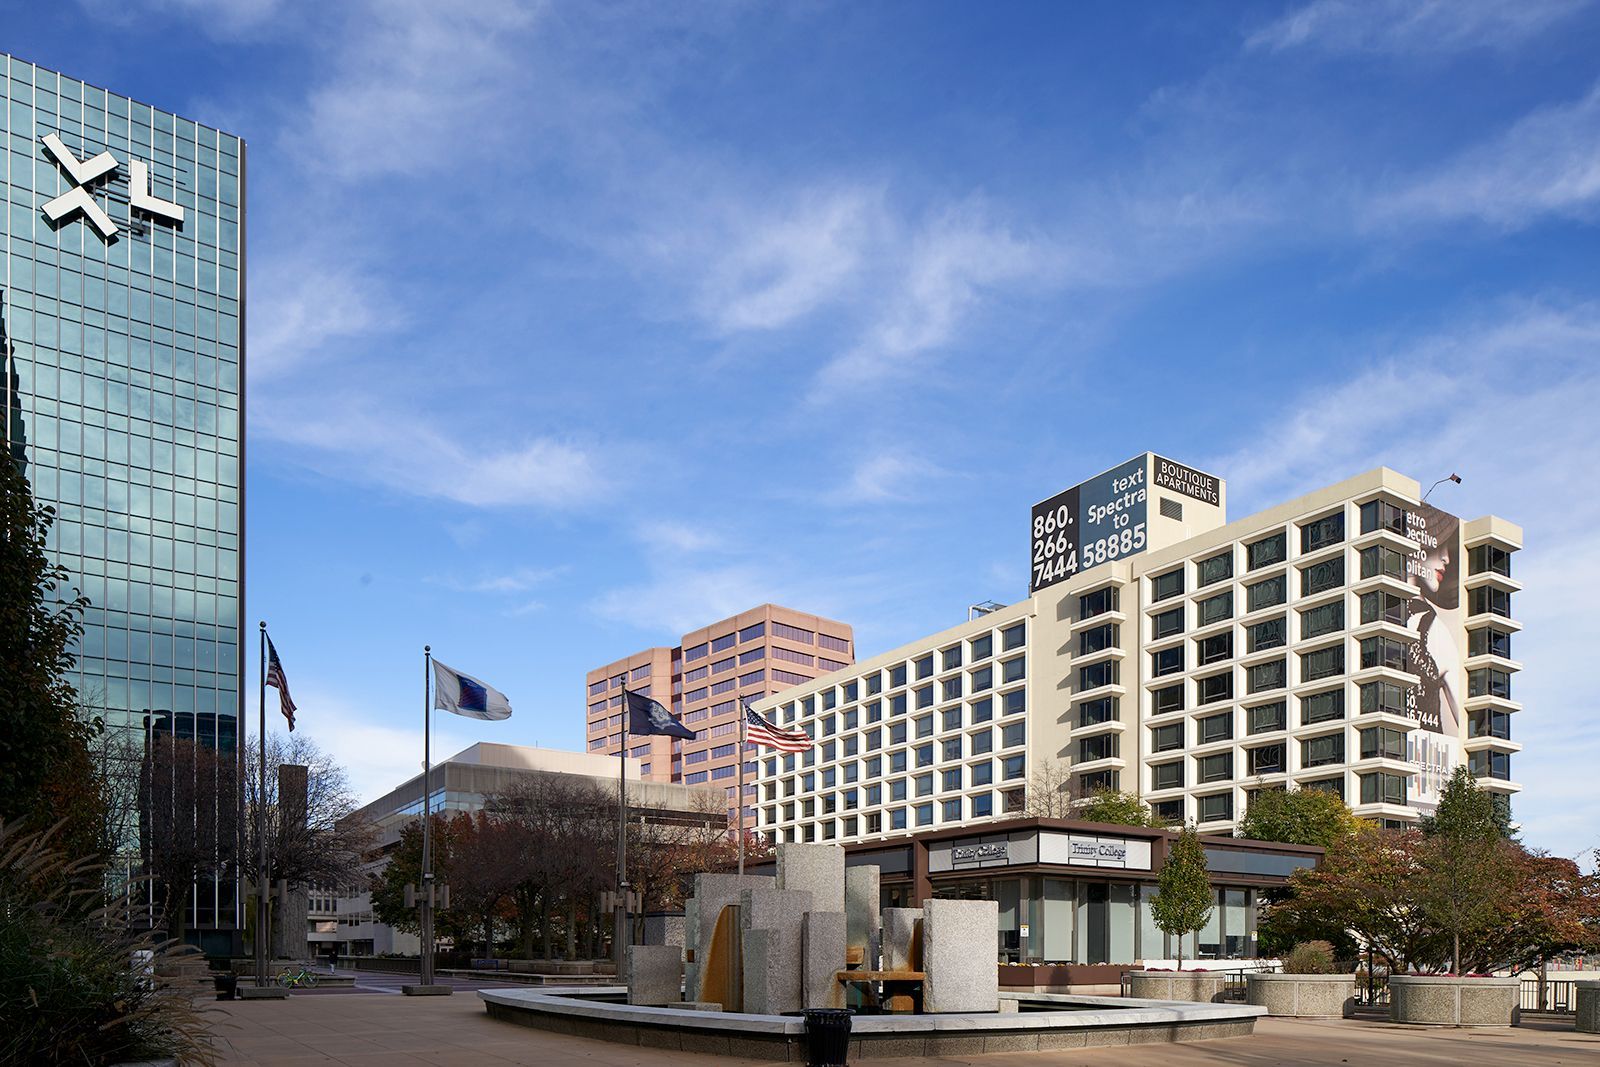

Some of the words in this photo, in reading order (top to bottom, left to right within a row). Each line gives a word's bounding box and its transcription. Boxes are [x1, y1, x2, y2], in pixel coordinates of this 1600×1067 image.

[40, 132, 185, 238] XL
[1112, 467, 1144, 494] text
[1156, 473, 1217, 503] APARTMENTS
[1161, 461, 1212, 490] BOUTIQUE
[1034, 505, 1074, 539] 860.
[1087, 487, 1147, 526] Spectra
[1113, 513, 1130, 530] to
[1406, 511, 1426, 529] etro
[1033, 529, 1073, 564] 266.
[1082, 522, 1147, 569] 58885
[1034, 550, 1078, 588] 7444
[1072, 843, 1098, 858] Trinity
[1099, 845, 1126, 860] College
